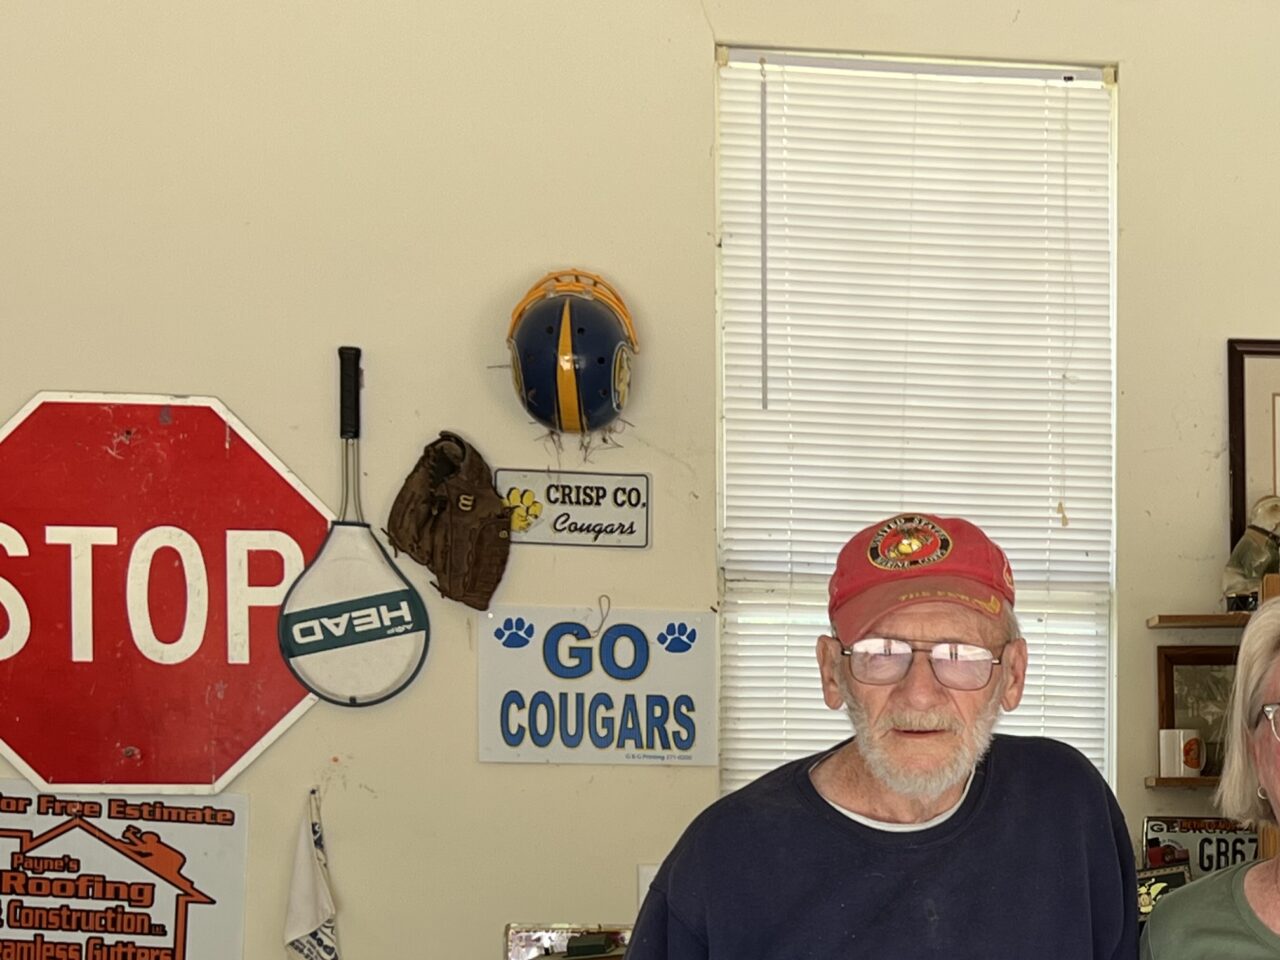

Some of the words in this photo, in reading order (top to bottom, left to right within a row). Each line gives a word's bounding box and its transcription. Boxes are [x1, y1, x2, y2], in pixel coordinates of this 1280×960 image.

[546, 484, 607, 508] CRISP
[613, 487, 647, 508] CO.
[553, 512, 636, 542] Cougars
[292, 601, 413, 645] HEAD
[543, 621, 650, 681] GO
[500, 690, 696, 751] COUGARS
[0, 792, 32, 814] or
[37, 794, 102, 818] Free
[108, 798, 235, 826] Estimate
[11, 852, 80, 875] Payne's
[0, 869, 155, 908] Roofing
[7, 899, 151, 934] Construction
